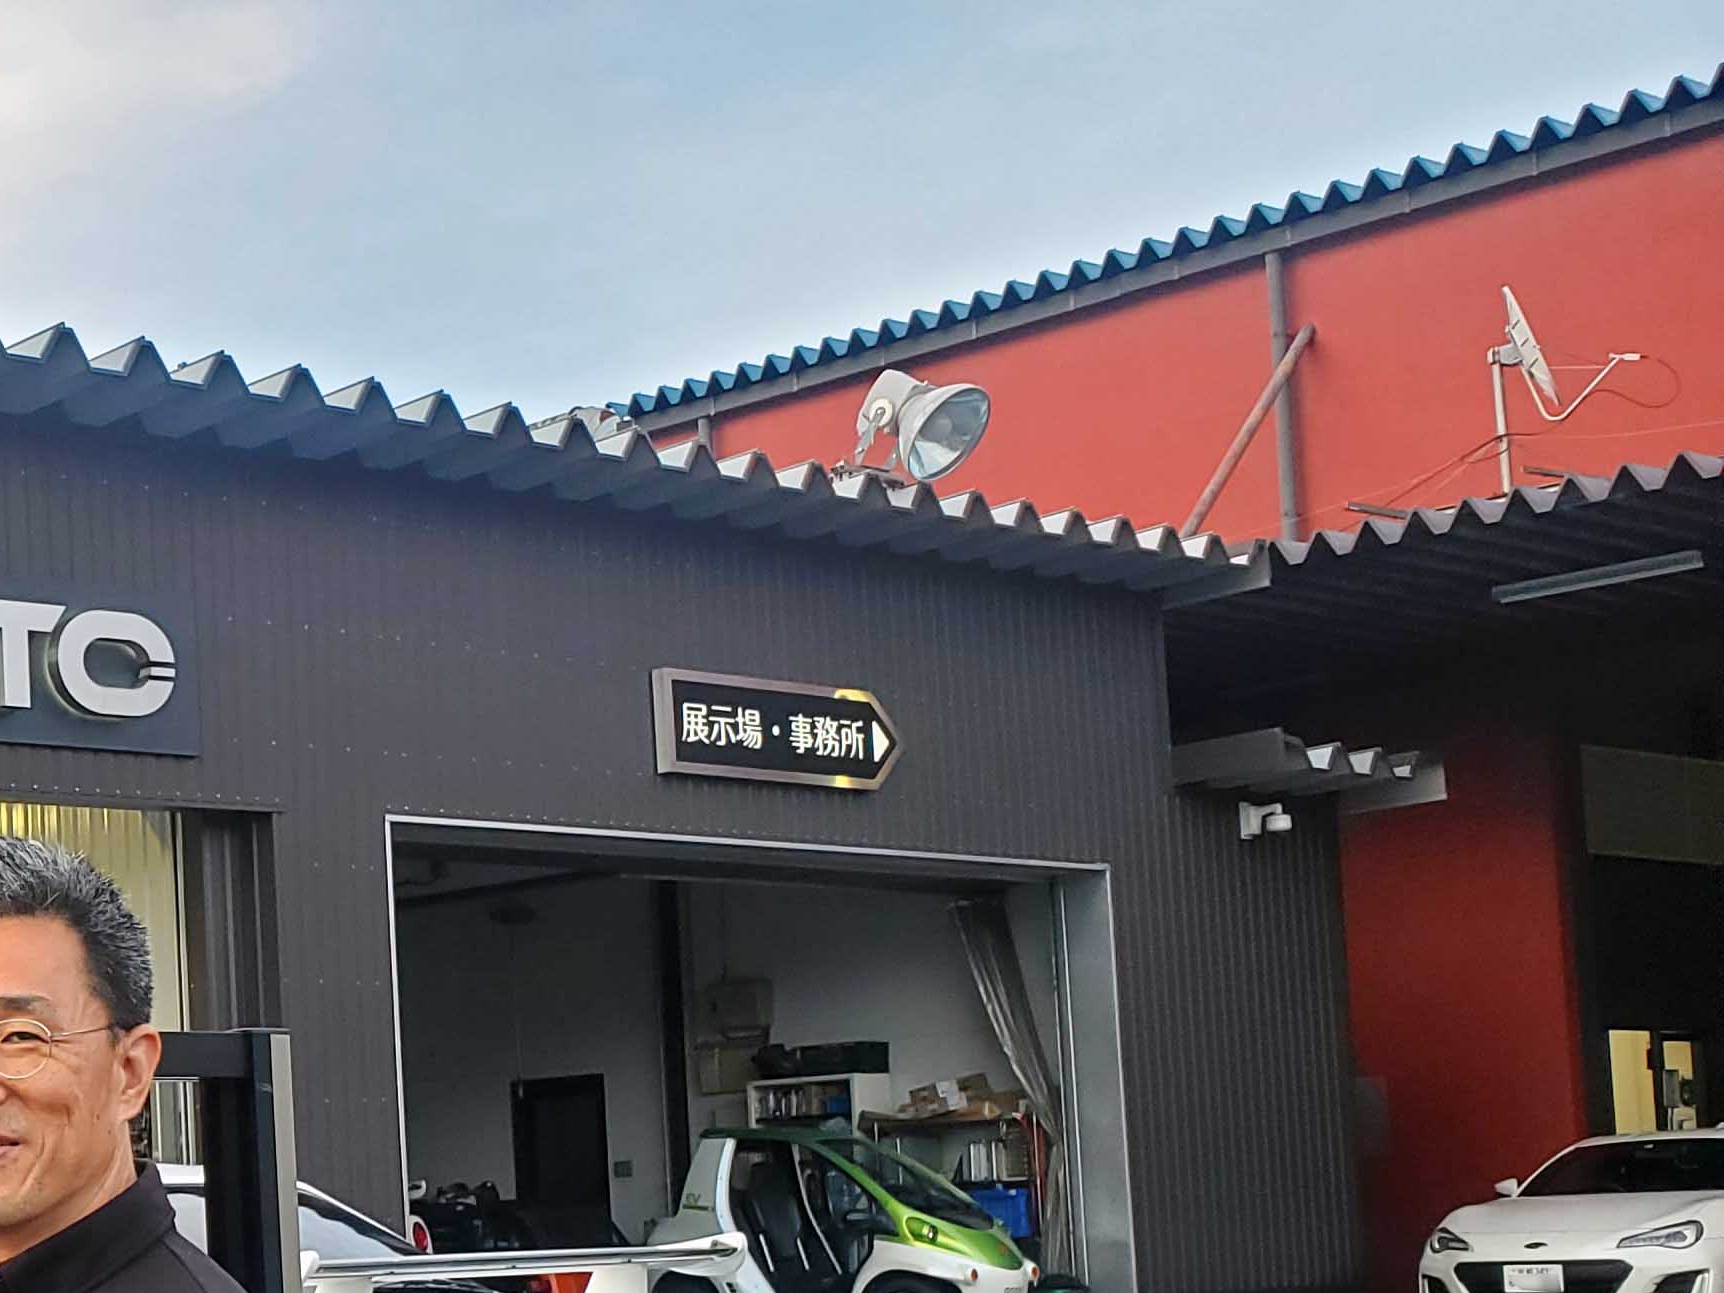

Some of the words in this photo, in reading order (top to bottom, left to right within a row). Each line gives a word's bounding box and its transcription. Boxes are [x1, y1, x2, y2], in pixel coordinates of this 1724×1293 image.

[681, 702, 866, 760] 展示場・事務所
